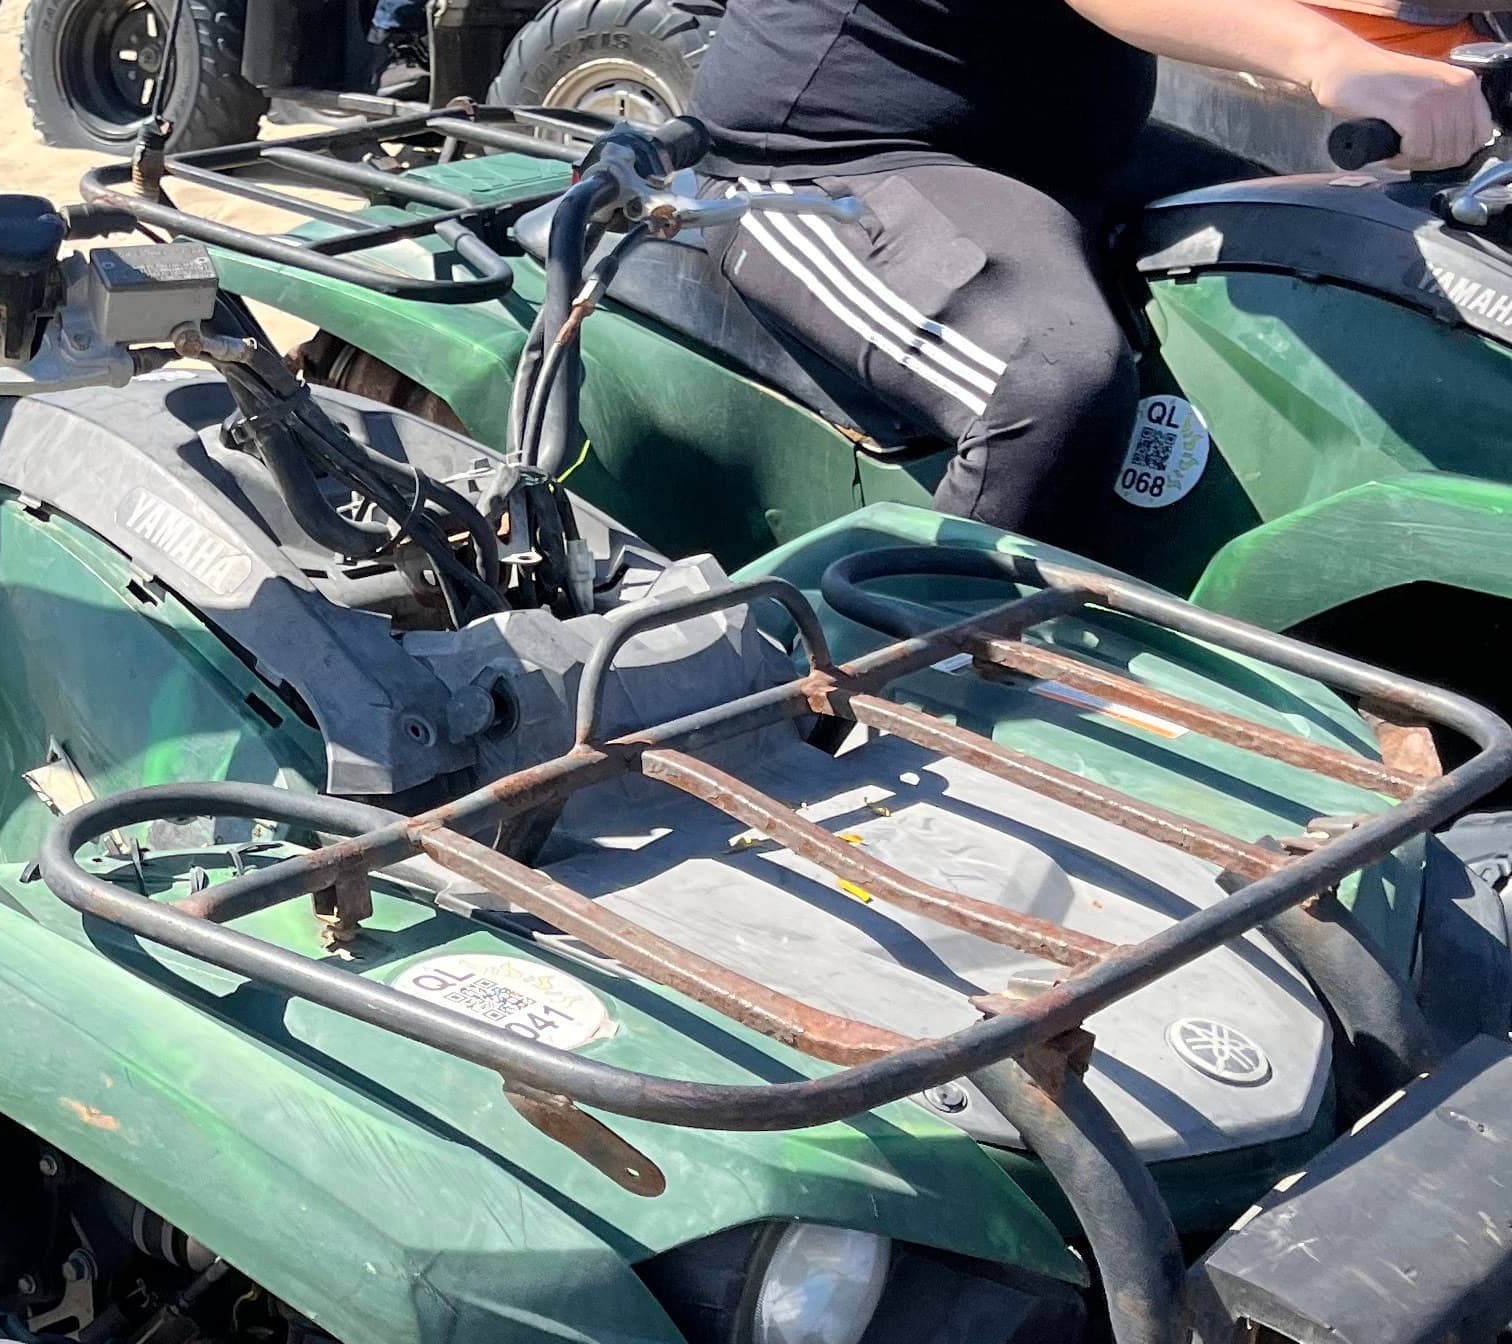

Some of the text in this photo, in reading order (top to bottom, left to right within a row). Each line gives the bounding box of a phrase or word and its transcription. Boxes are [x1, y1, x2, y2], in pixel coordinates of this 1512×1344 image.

[1417, 263, 1512, 328] YAMAH
[1147, 401, 1180, 429] QL
[1121, 468, 1166, 498] 068
[126, 490, 244, 594] YAMAHA
[412, 968, 476, 992] QL
[504, 1004, 575, 1042] 041
